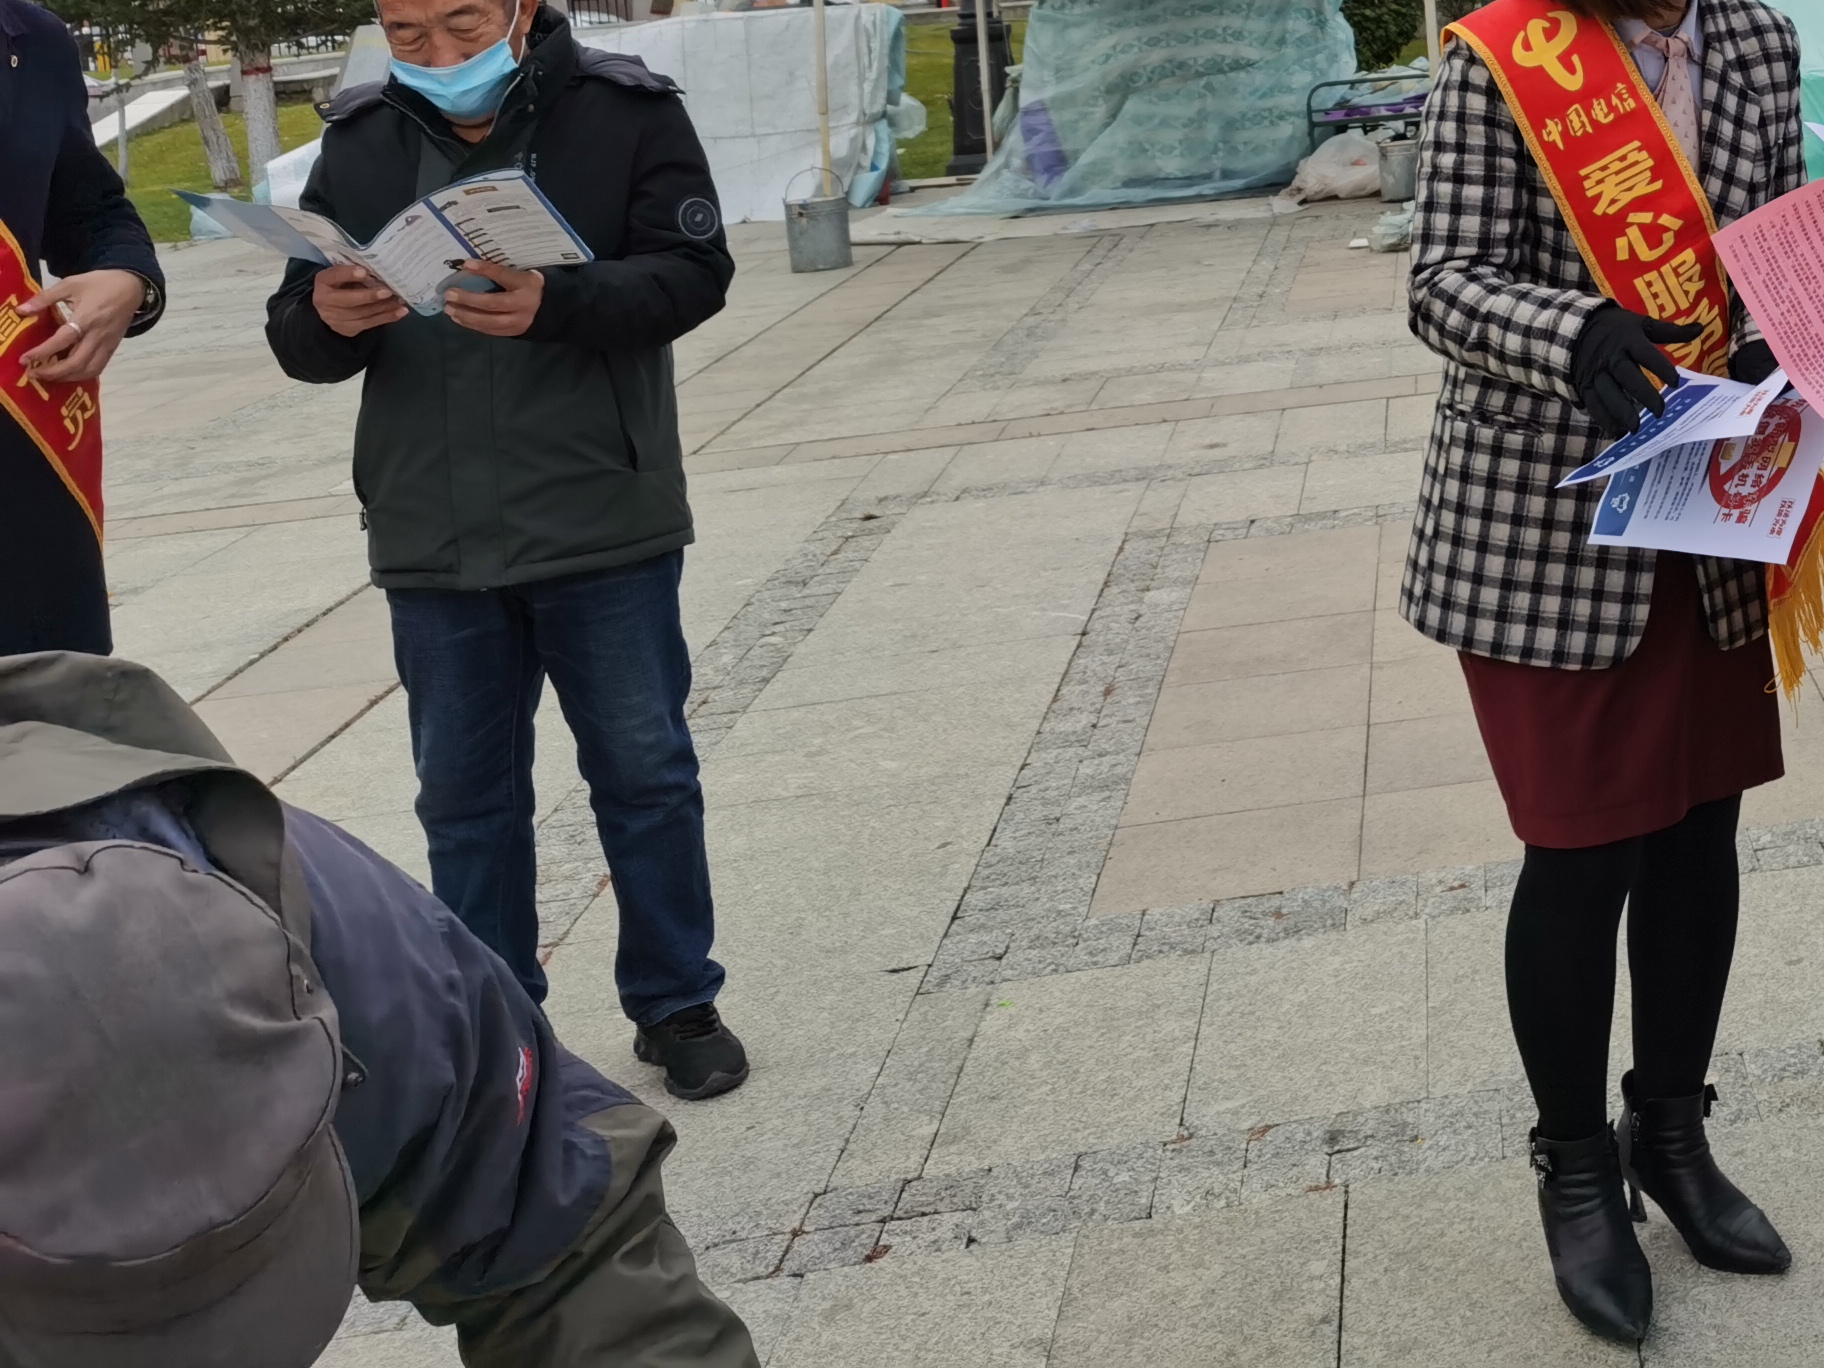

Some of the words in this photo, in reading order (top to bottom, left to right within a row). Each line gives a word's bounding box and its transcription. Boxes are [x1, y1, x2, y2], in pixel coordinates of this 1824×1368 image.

[1542, 82, 1637, 150] 中国电信
[1578, 140, 1729, 377] 爱心服务
